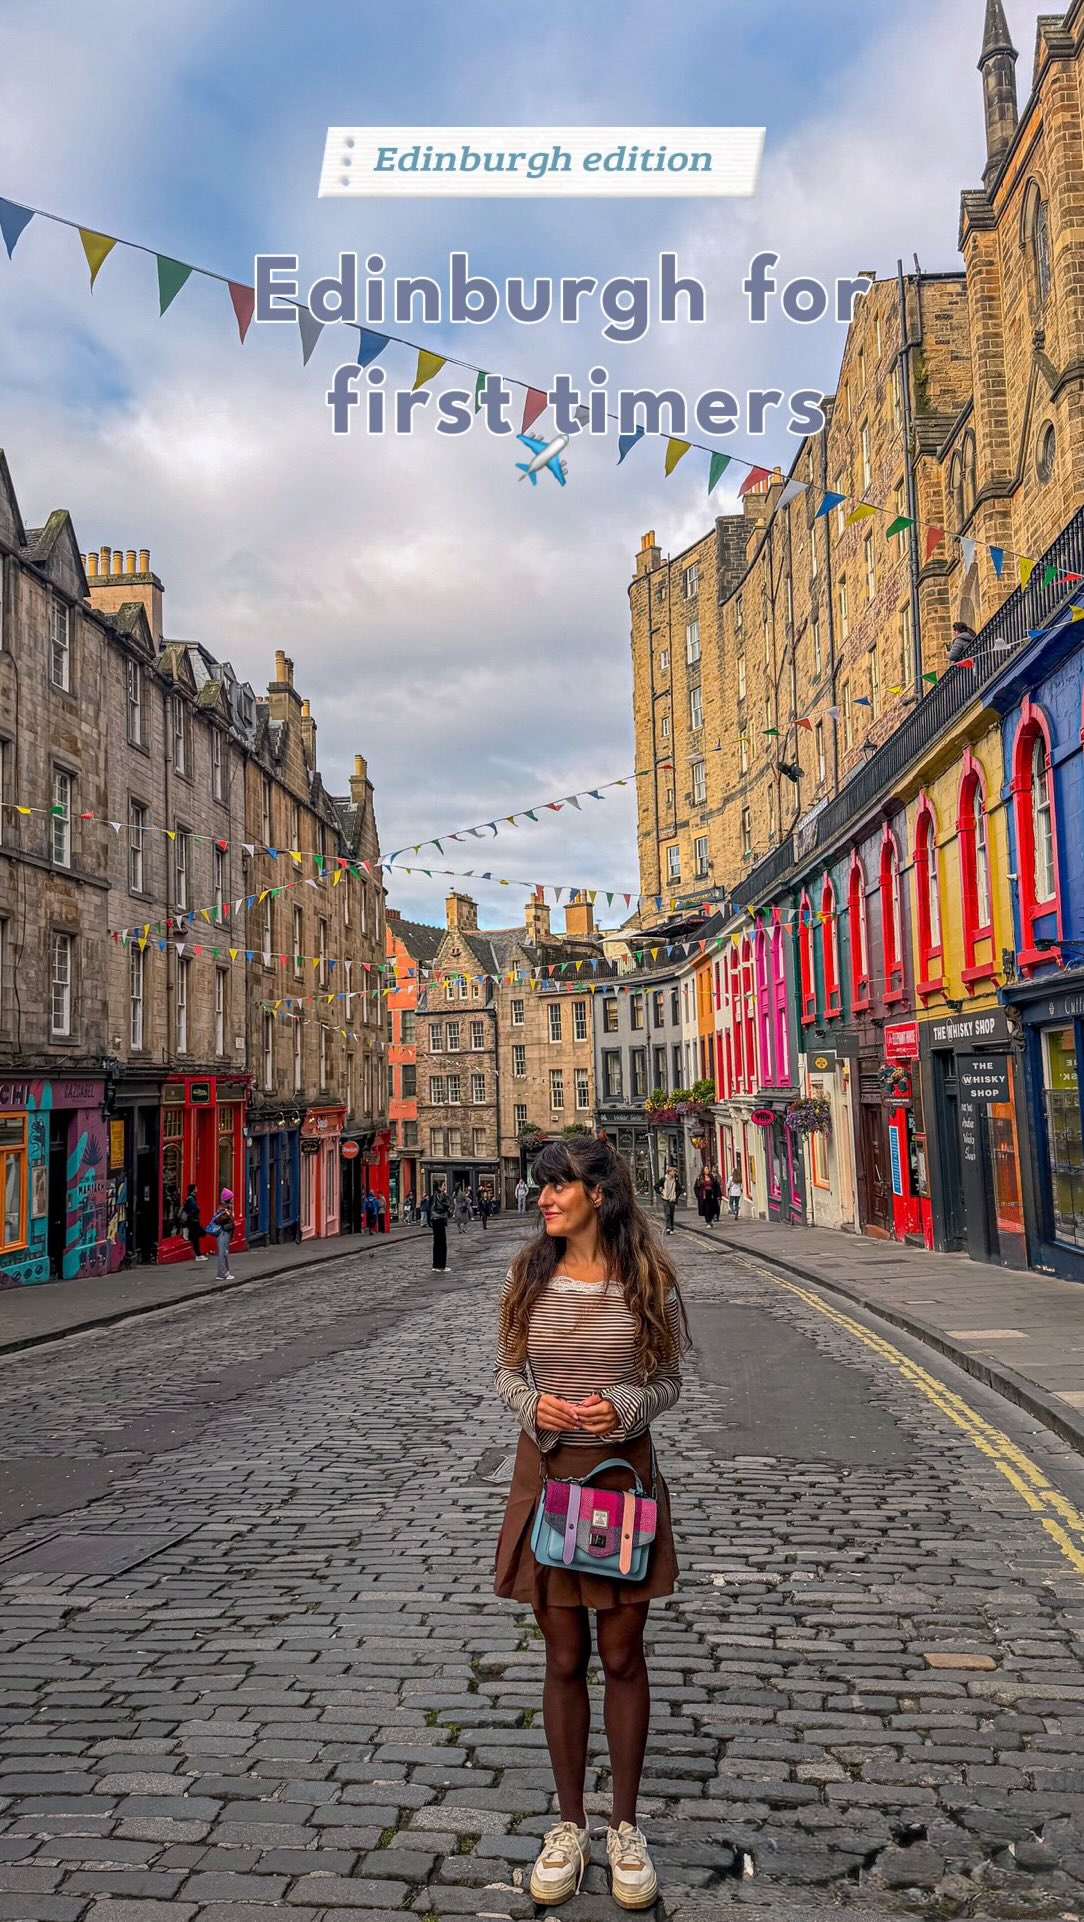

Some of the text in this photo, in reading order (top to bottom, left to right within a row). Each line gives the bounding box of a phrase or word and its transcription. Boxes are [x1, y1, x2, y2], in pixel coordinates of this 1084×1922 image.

[933, 1026, 947, 1041] THE
[946, 1020, 974, 1040] WHISKY
[975, 1018, 995, 1036] SHOP
[972, 1062, 994, 1070] THE
[962, 1075, 1006, 1085] WHISKY
[970, 1089, 1000, 1098] SHOP
